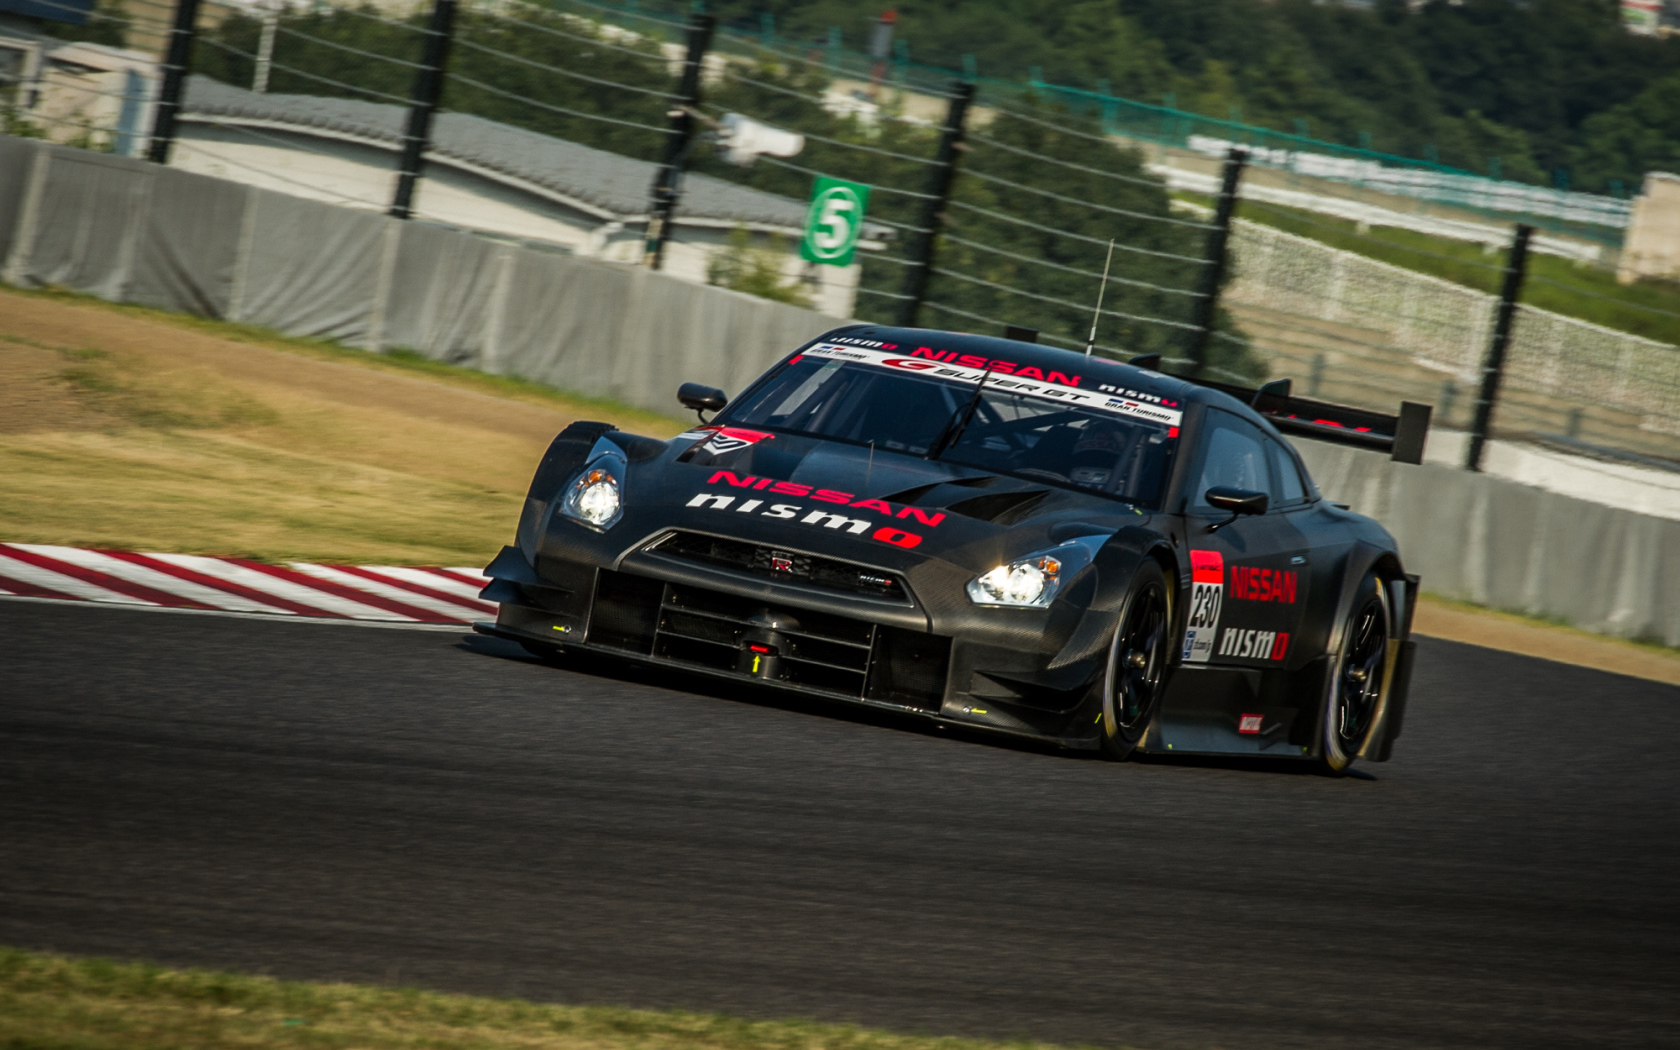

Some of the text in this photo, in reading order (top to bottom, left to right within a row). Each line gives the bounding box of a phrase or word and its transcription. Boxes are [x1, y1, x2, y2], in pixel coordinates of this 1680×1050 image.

[813, 198, 855, 249] 5
[910, 346, 1082, 387] NISSAN
[933, 368, 1041, 392] SUPER
[1043, 389, 1090, 401] GT
[1105, 402, 1171, 421] GRAN TURISMO
[707, 470, 946, 527] NISSAN
[685, 493, 922, 549] nismo
[1230, 565, 1297, 604] NISSAN
[1189, 584, 1220, 629] 230
[1218, 627, 1290, 660] nismo
